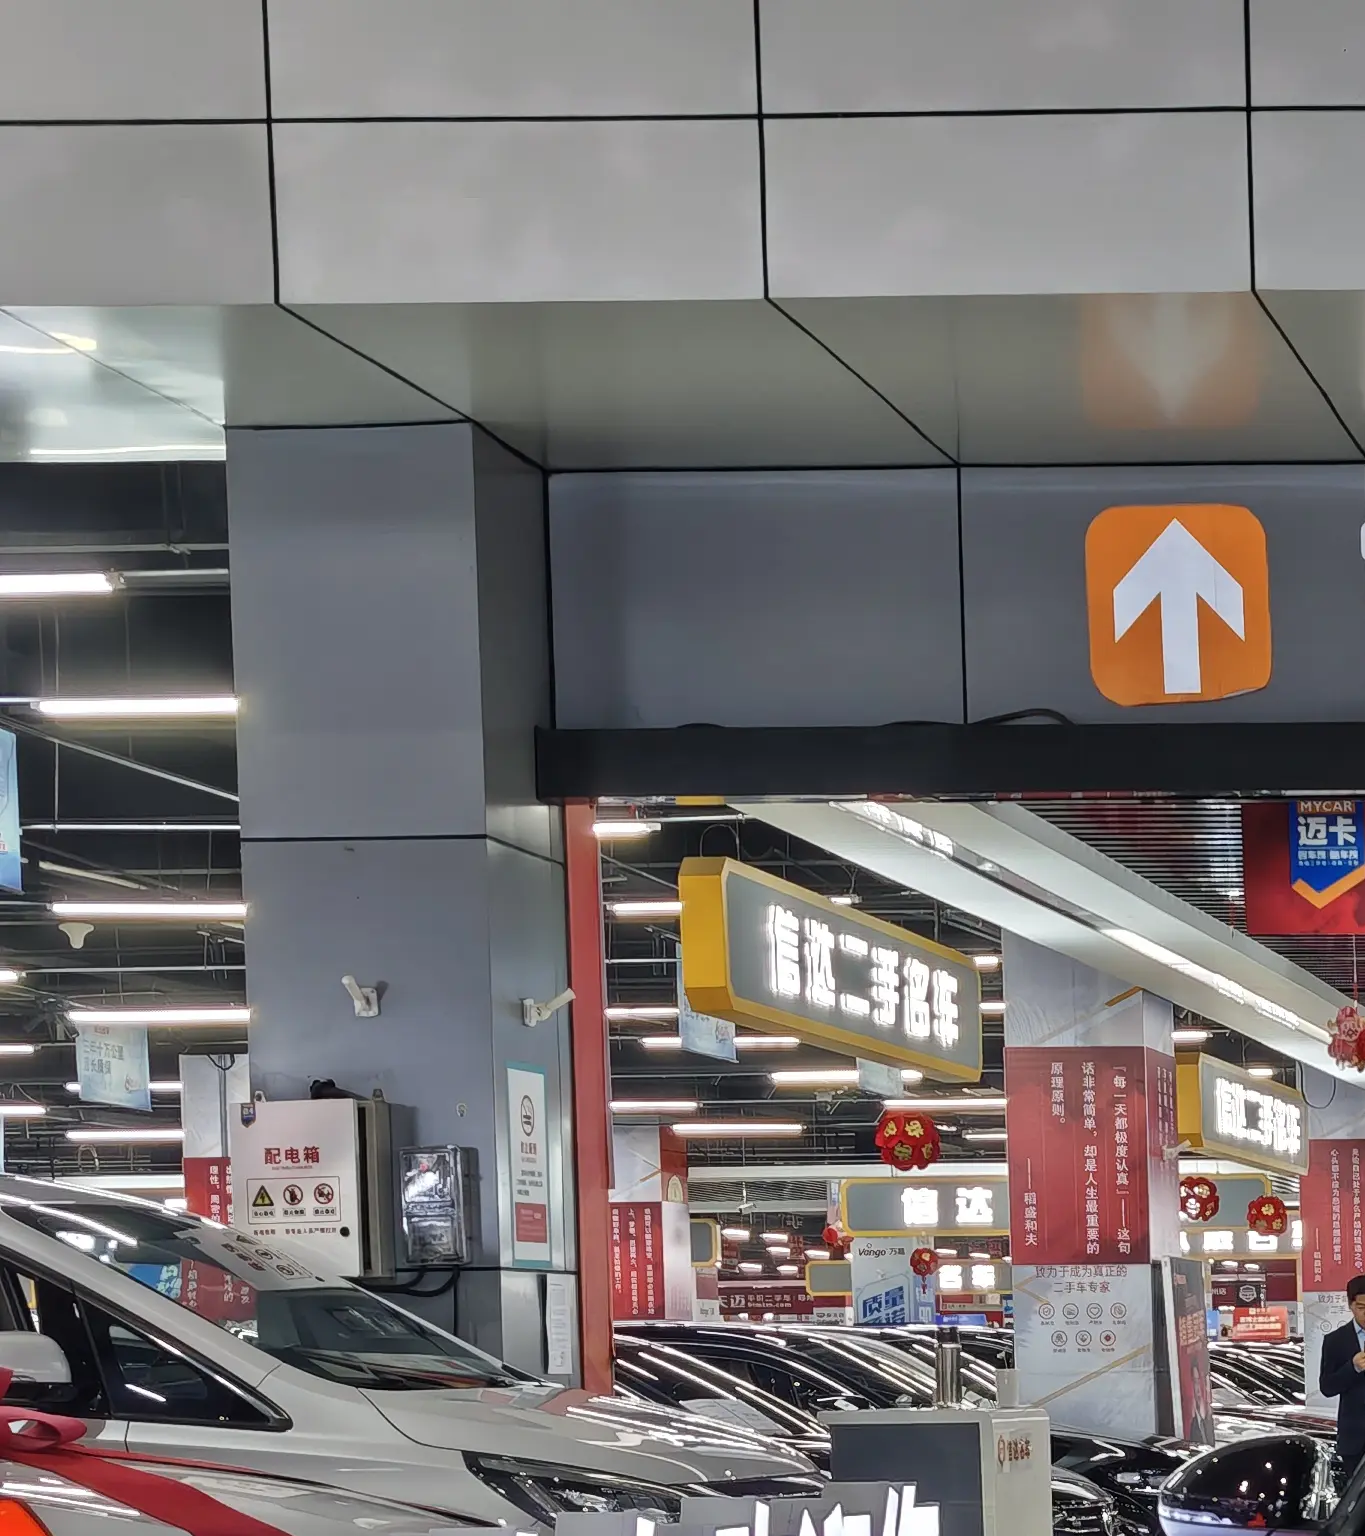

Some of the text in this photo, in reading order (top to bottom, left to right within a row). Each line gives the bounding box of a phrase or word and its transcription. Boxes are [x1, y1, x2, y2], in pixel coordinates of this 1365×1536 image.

[1300, 801, 1354, 813] MYCAR
[1297, 816, 1357, 846] 迈卡
[264, 1145, 320, 1165] 配电箱
[1053, 1281, 1111, 1293] 二手车专家
